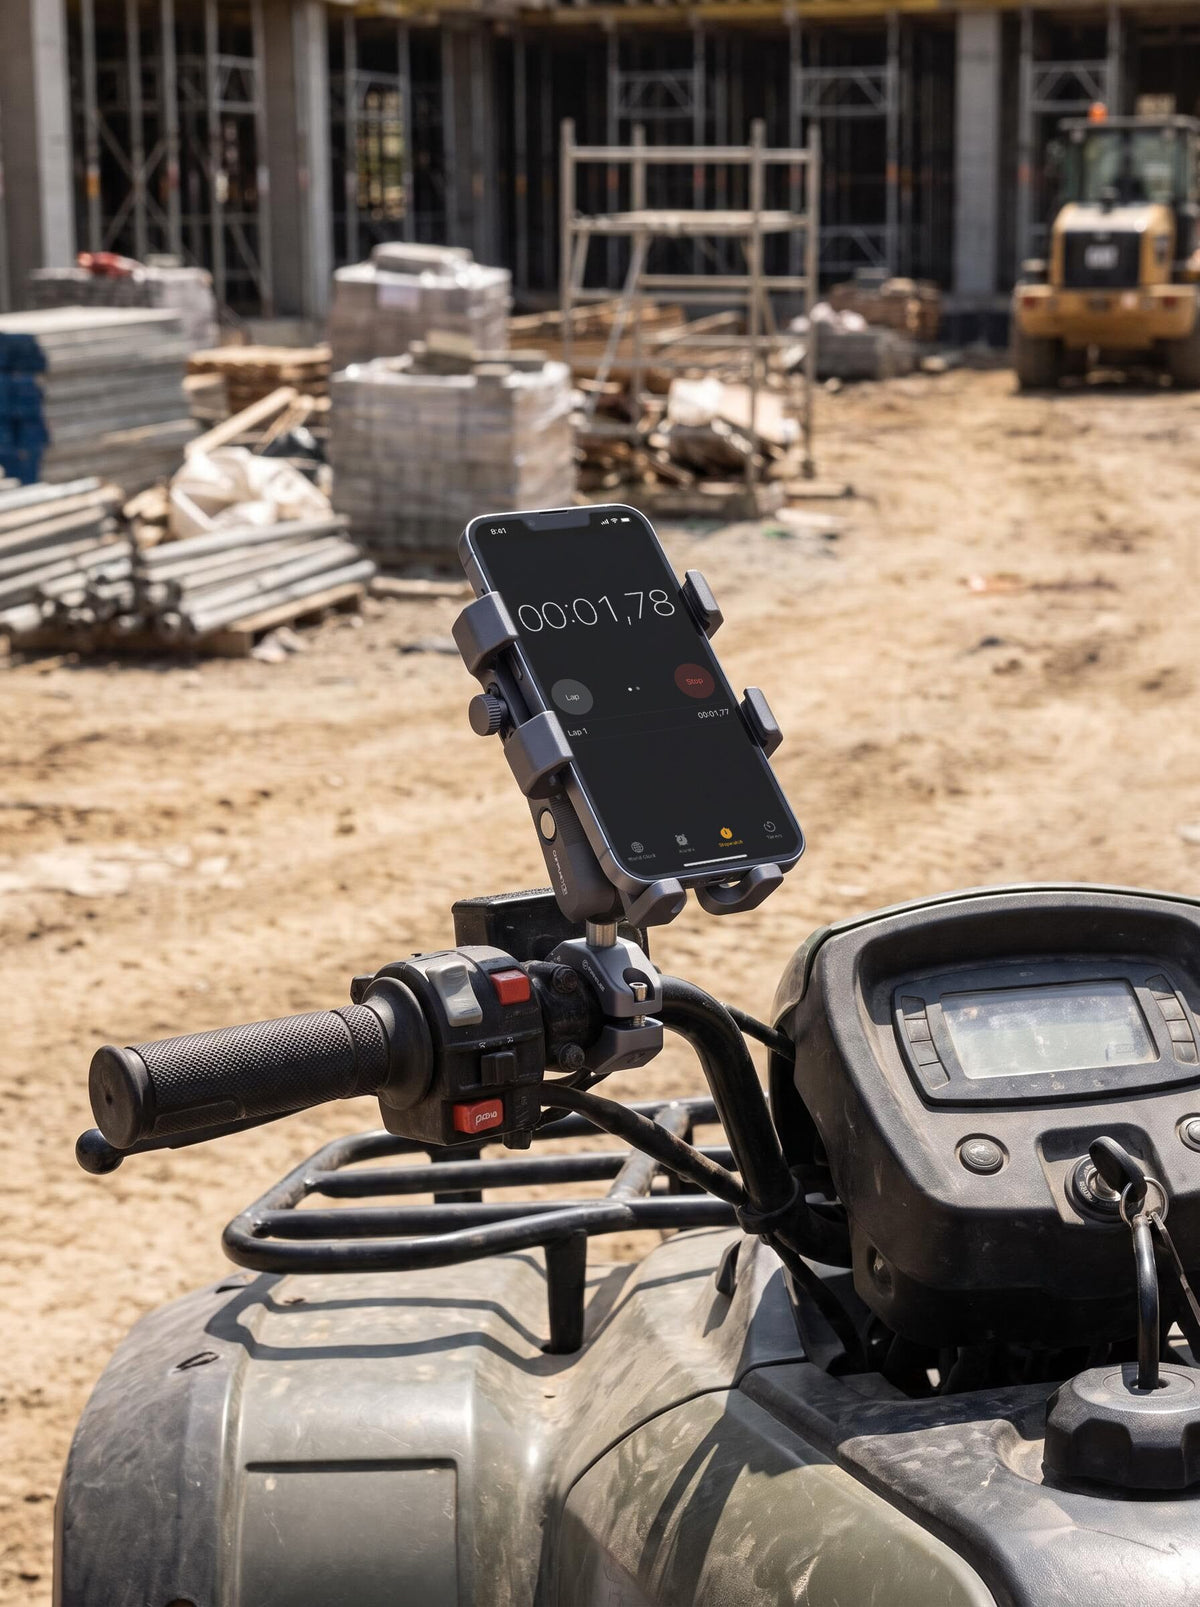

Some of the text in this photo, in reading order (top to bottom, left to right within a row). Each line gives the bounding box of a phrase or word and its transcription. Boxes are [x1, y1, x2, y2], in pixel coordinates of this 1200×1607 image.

[518, 589, 675, 632] 00:01,78
[697, 708, 729, 719] 00:01,77
[567, 729, 582, 737] Lap
